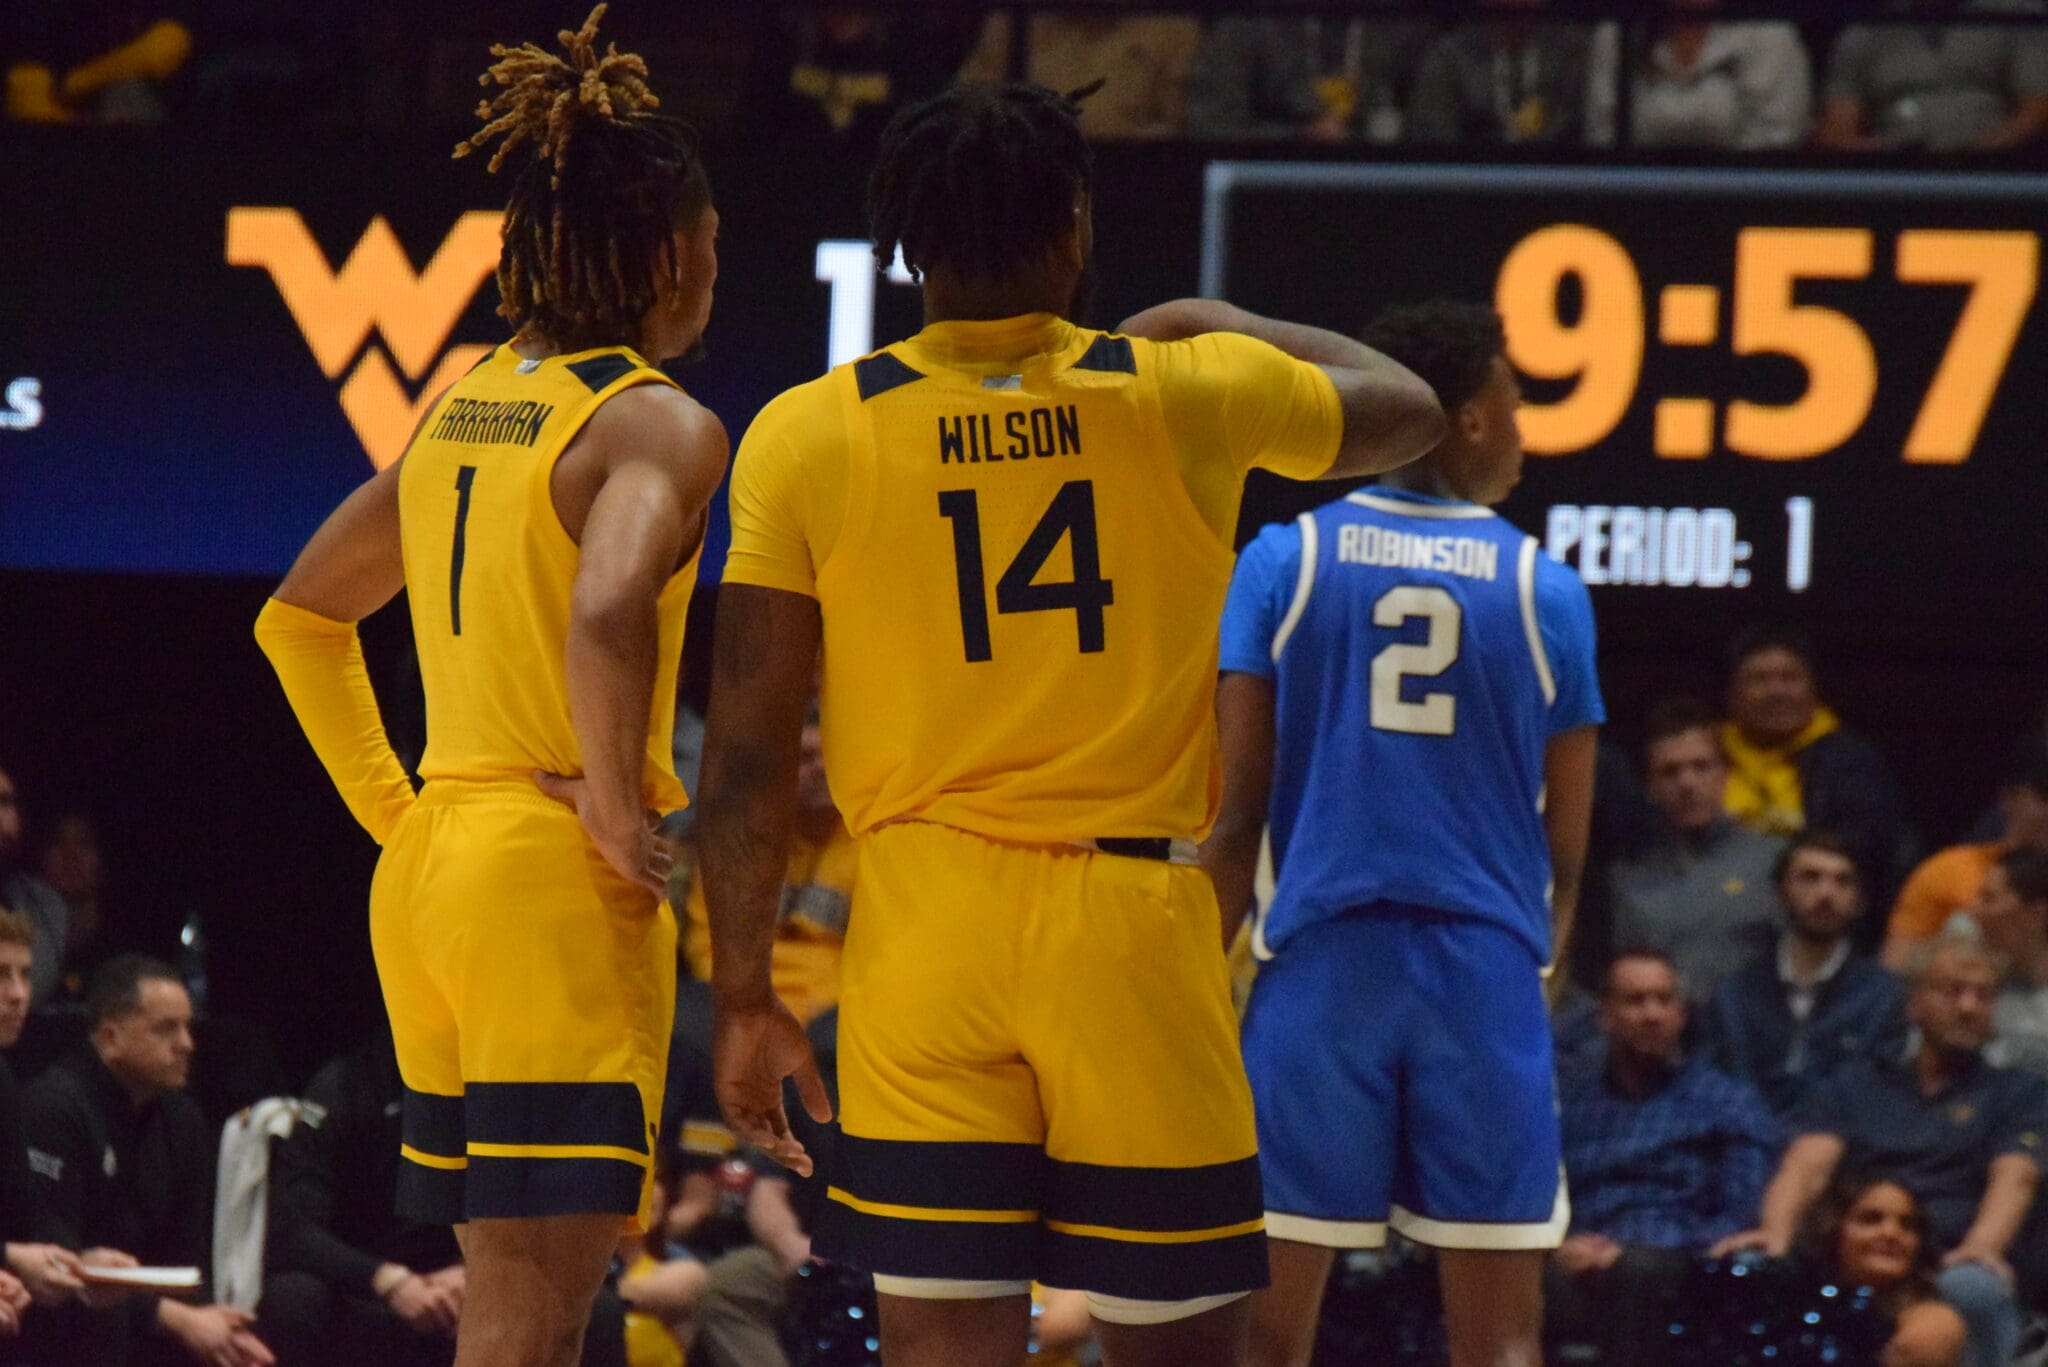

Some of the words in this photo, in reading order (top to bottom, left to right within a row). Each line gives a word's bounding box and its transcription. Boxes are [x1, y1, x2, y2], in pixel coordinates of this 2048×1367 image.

[1495, 223, 2038, 463] 9:57
[430, 397, 554, 448] FARRAKHAN
[938, 405, 1081, 464] WILSON
[450, 465, 477, 636] 1
[938, 480, 1114, 663] 14
[1338, 524, 1498, 581] ROBINSON
[1546, 503, 1752, 588] PERIOD:
[1785, 496, 1812, 593] 1
[1369, 584, 1462, 736] 2
